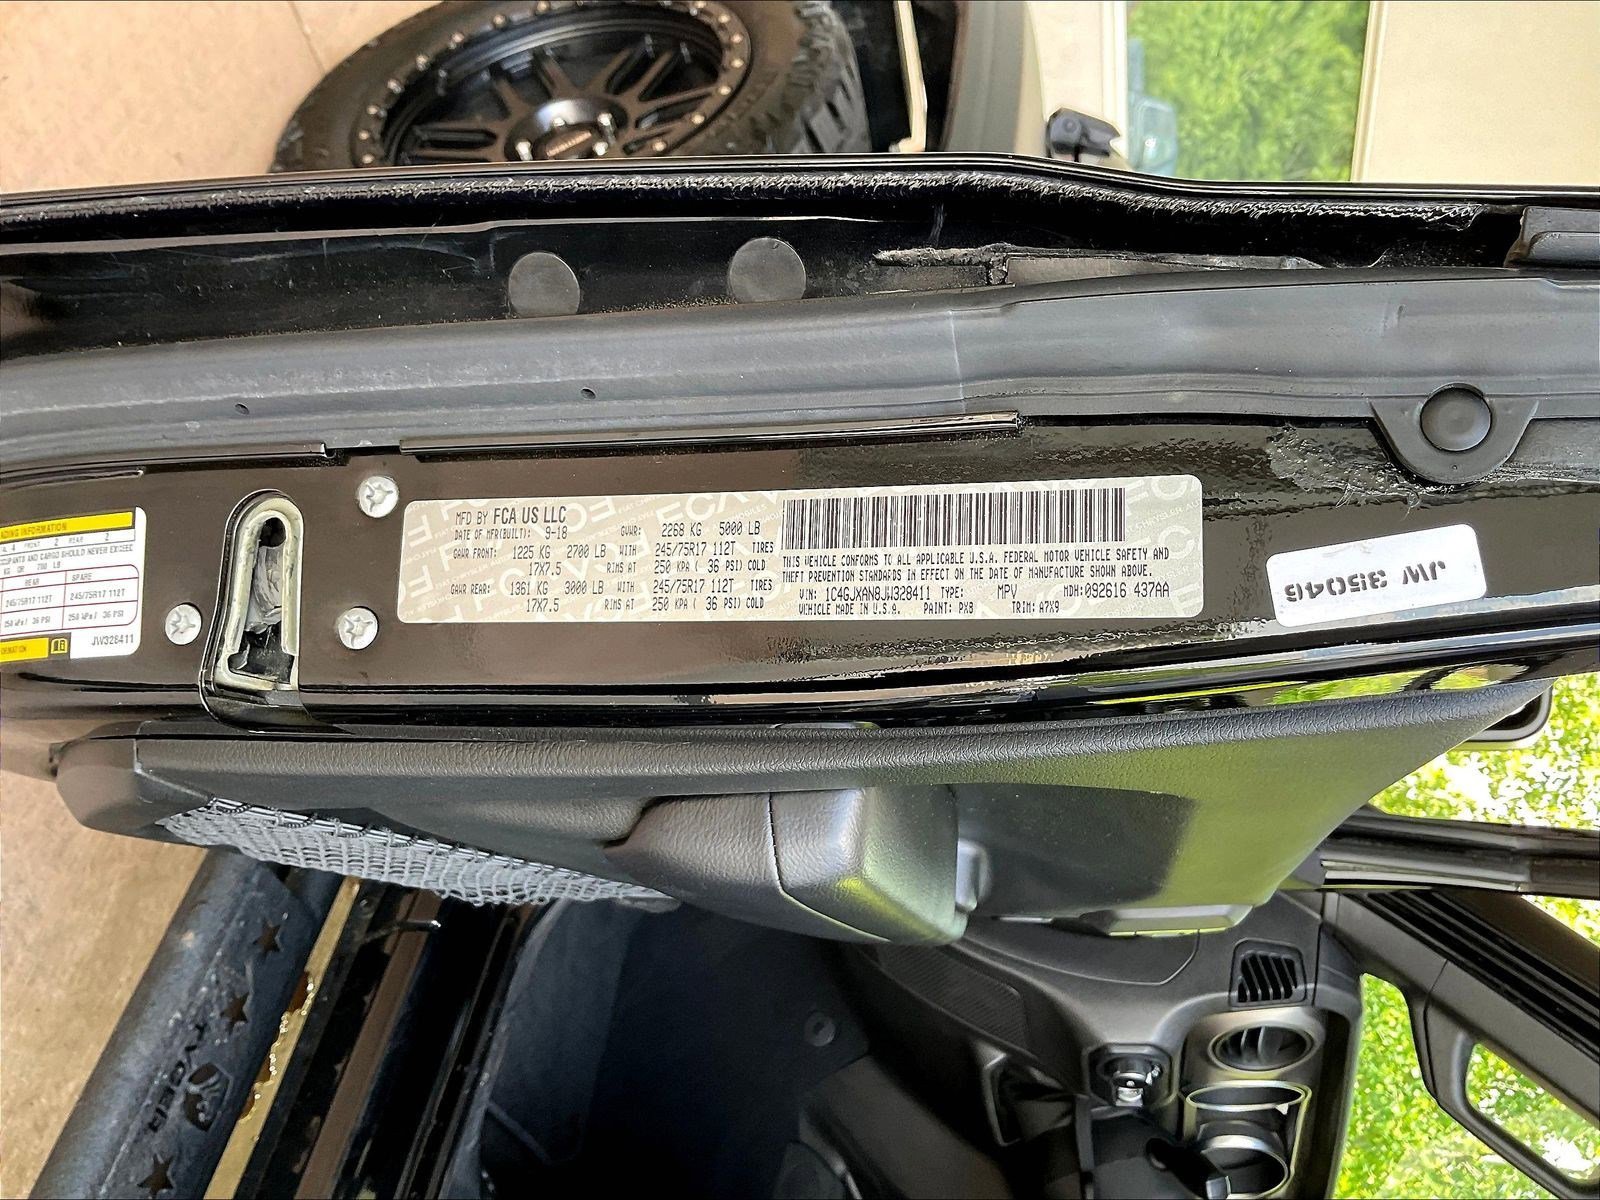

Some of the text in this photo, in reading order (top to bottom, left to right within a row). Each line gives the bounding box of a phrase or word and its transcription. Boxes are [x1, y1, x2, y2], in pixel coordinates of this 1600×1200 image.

[455, 505, 567, 525] MFD BY FCA US LLC
[21, 523, 67, 536] INFORMATION
[454, 529, 471, 541] DATE
[474, 529, 483, 540] OF
[545, 526, 568, 540] 9-18
[620, 525, 641, 537] GVWR:
[661, 523, 685, 538] 2268
[690, 523, 702, 537] KG
[719, 521, 743, 536] 5000
[748, 520, 761, 535] LB
[86, 546, 108, 555] NEVER
[453, 541, 774, 560] GAWR FRONT: 1225 KG 2700 LB WITH 245/75R17 112T TIRES
[783, 547, 1169, 568] THIS VEHICLE CONFORMS TO ALL APPLICABLE U.S.A. FEDERAL MOTOR VEHICLE SAFETY AND
[528, 562, 562, 576] 17X7.5
[607, 562, 624, 574] RIMS
[627, 561, 636, 573] AT
[654, 560, 671, 574] 250
[677, 561, 690, 573] KPA
[707, 559, 720, 573] 36
[725, 559, 743, 572] PSI)
[747, 559, 766, 571] COLD
[782, 564, 1153, 583] THEFT PREVENTION STANDARDS IN EFFECT ON THE DATE OF MANUFACTURE SHOWN ABOVE.
[72, 573, 93, 581] SPARE
[1284, 560, 1446, 602] JW 35046
[109, 588, 125, 597] 112T
[450, 578, 773, 595] GAWR REAR: 1361 KG 3000 LB WITH 245/75R17 112T TIRES
[800, 589, 817, 600] VIN:
[825, 586, 930, 602] 1C4GJXAN8JW328411
[941, 586, 964, 599] TYPE:
[997, 584, 1017, 599] MPV
[1134, 581, 1170, 598] 437AA
[526, 598, 560, 613] 17X7.5
[604, 599, 622, 610] RIMS
[625, 598, 635, 610] AT
[652, 597, 669, 611] 250
[675, 598, 688, 610] KPA
[705, 596, 718, 611] 36
[723, 597, 741, 609] PSI)
[746, 597, 764, 609] COLD
[798, 600, 1060, 615] VEHICLE MADE IN U.S.A. PAINT: PX8 TRIM: A7X9
[113, 610, 124, 618] PSI
